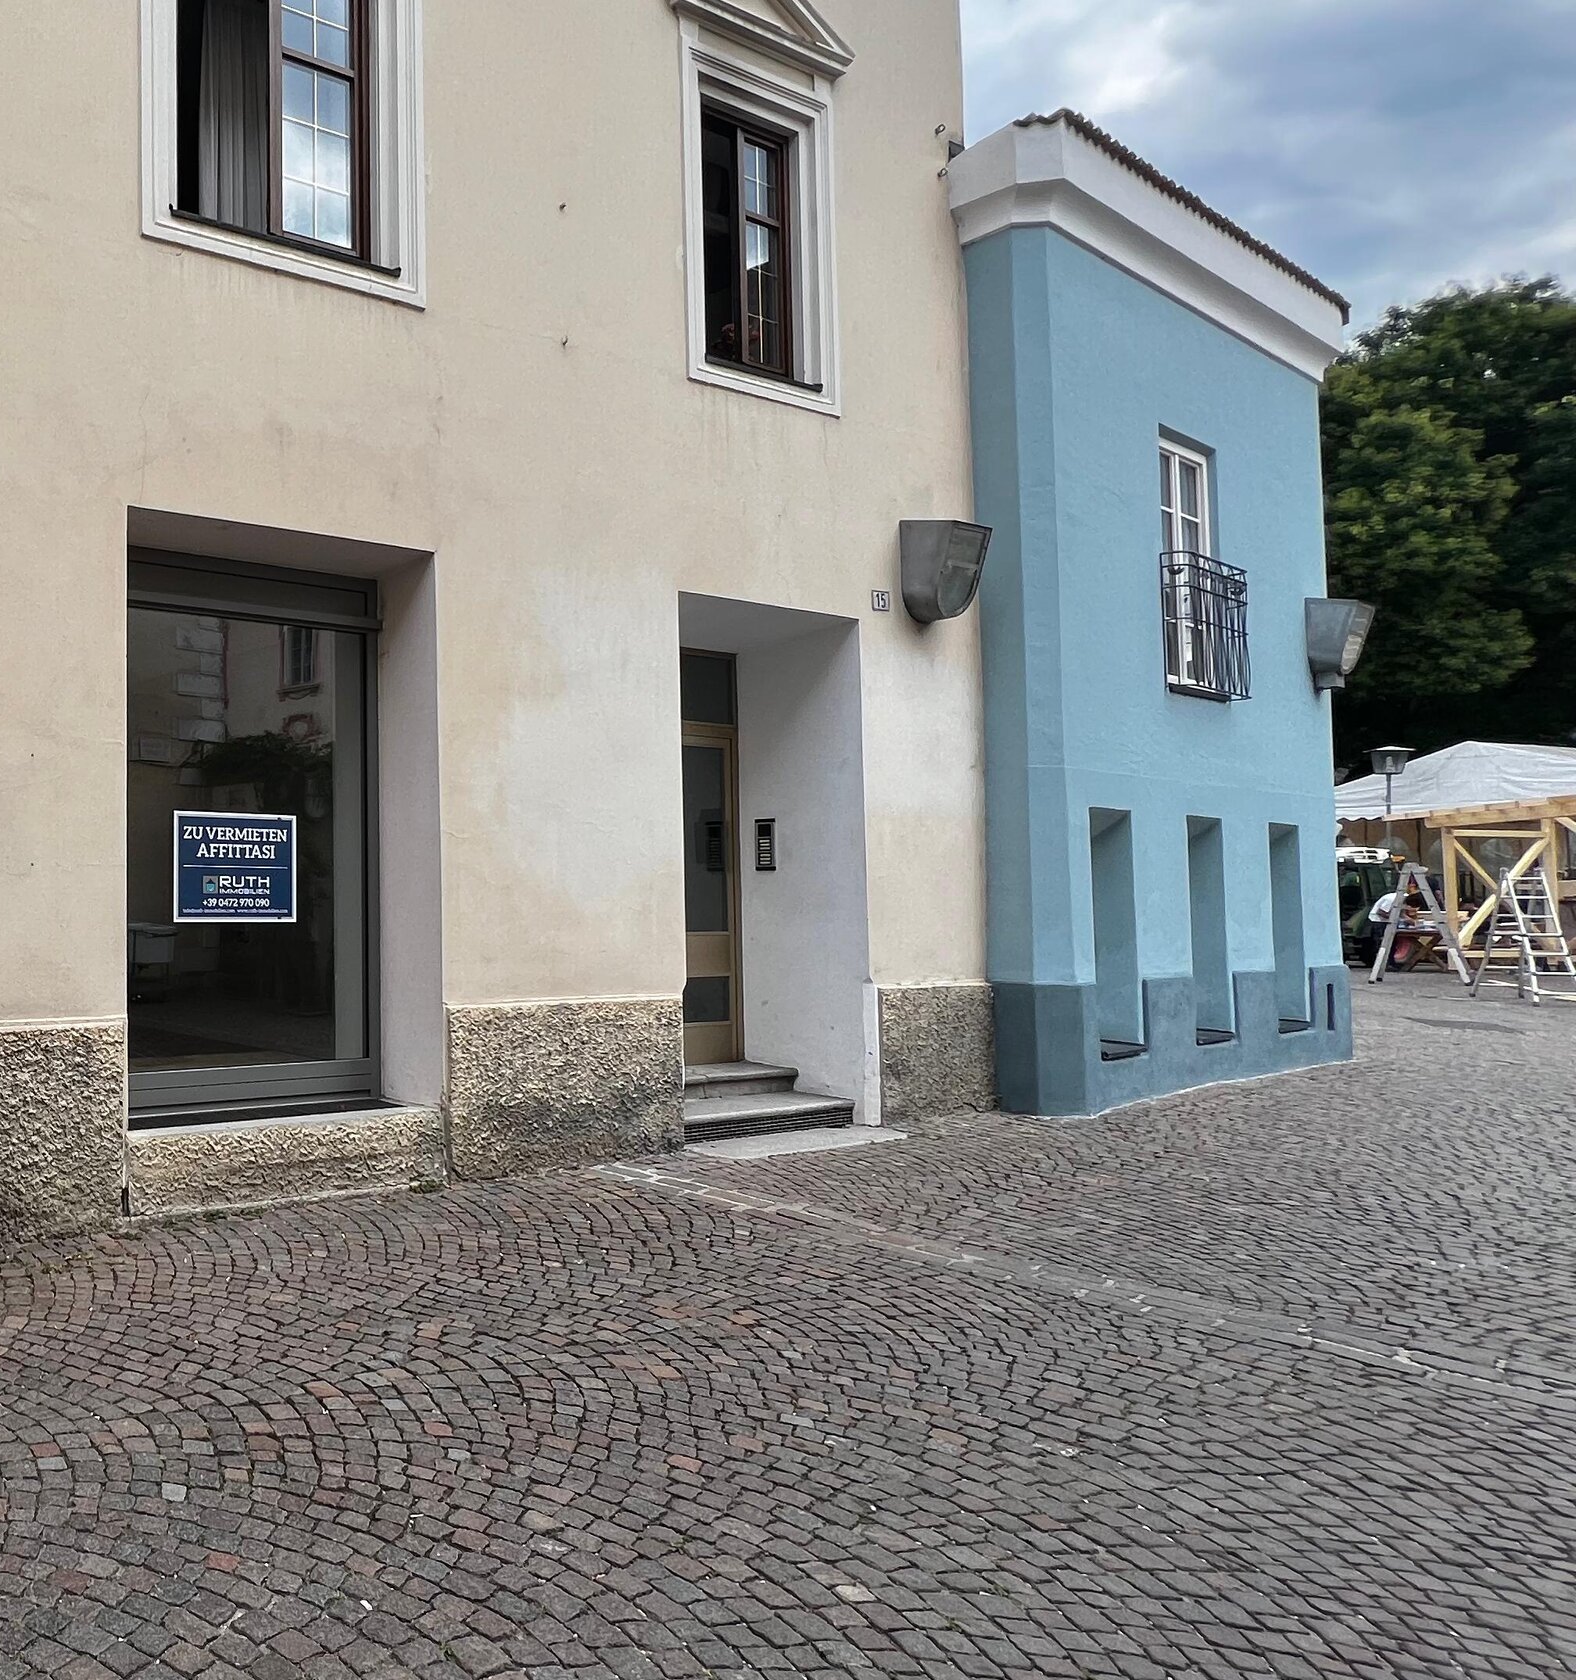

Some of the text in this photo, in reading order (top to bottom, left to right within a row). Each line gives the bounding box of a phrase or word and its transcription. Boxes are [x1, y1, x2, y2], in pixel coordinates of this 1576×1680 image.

[876, 593, 886, 608] 15
[183, 826, 287, 842] ZU VERMIETEN
[196, 843, 275, 859] AFFITTASI
[219, 875, 269, 887] RUTH
[202, 898, 270, 907] +39 0472 970 090
